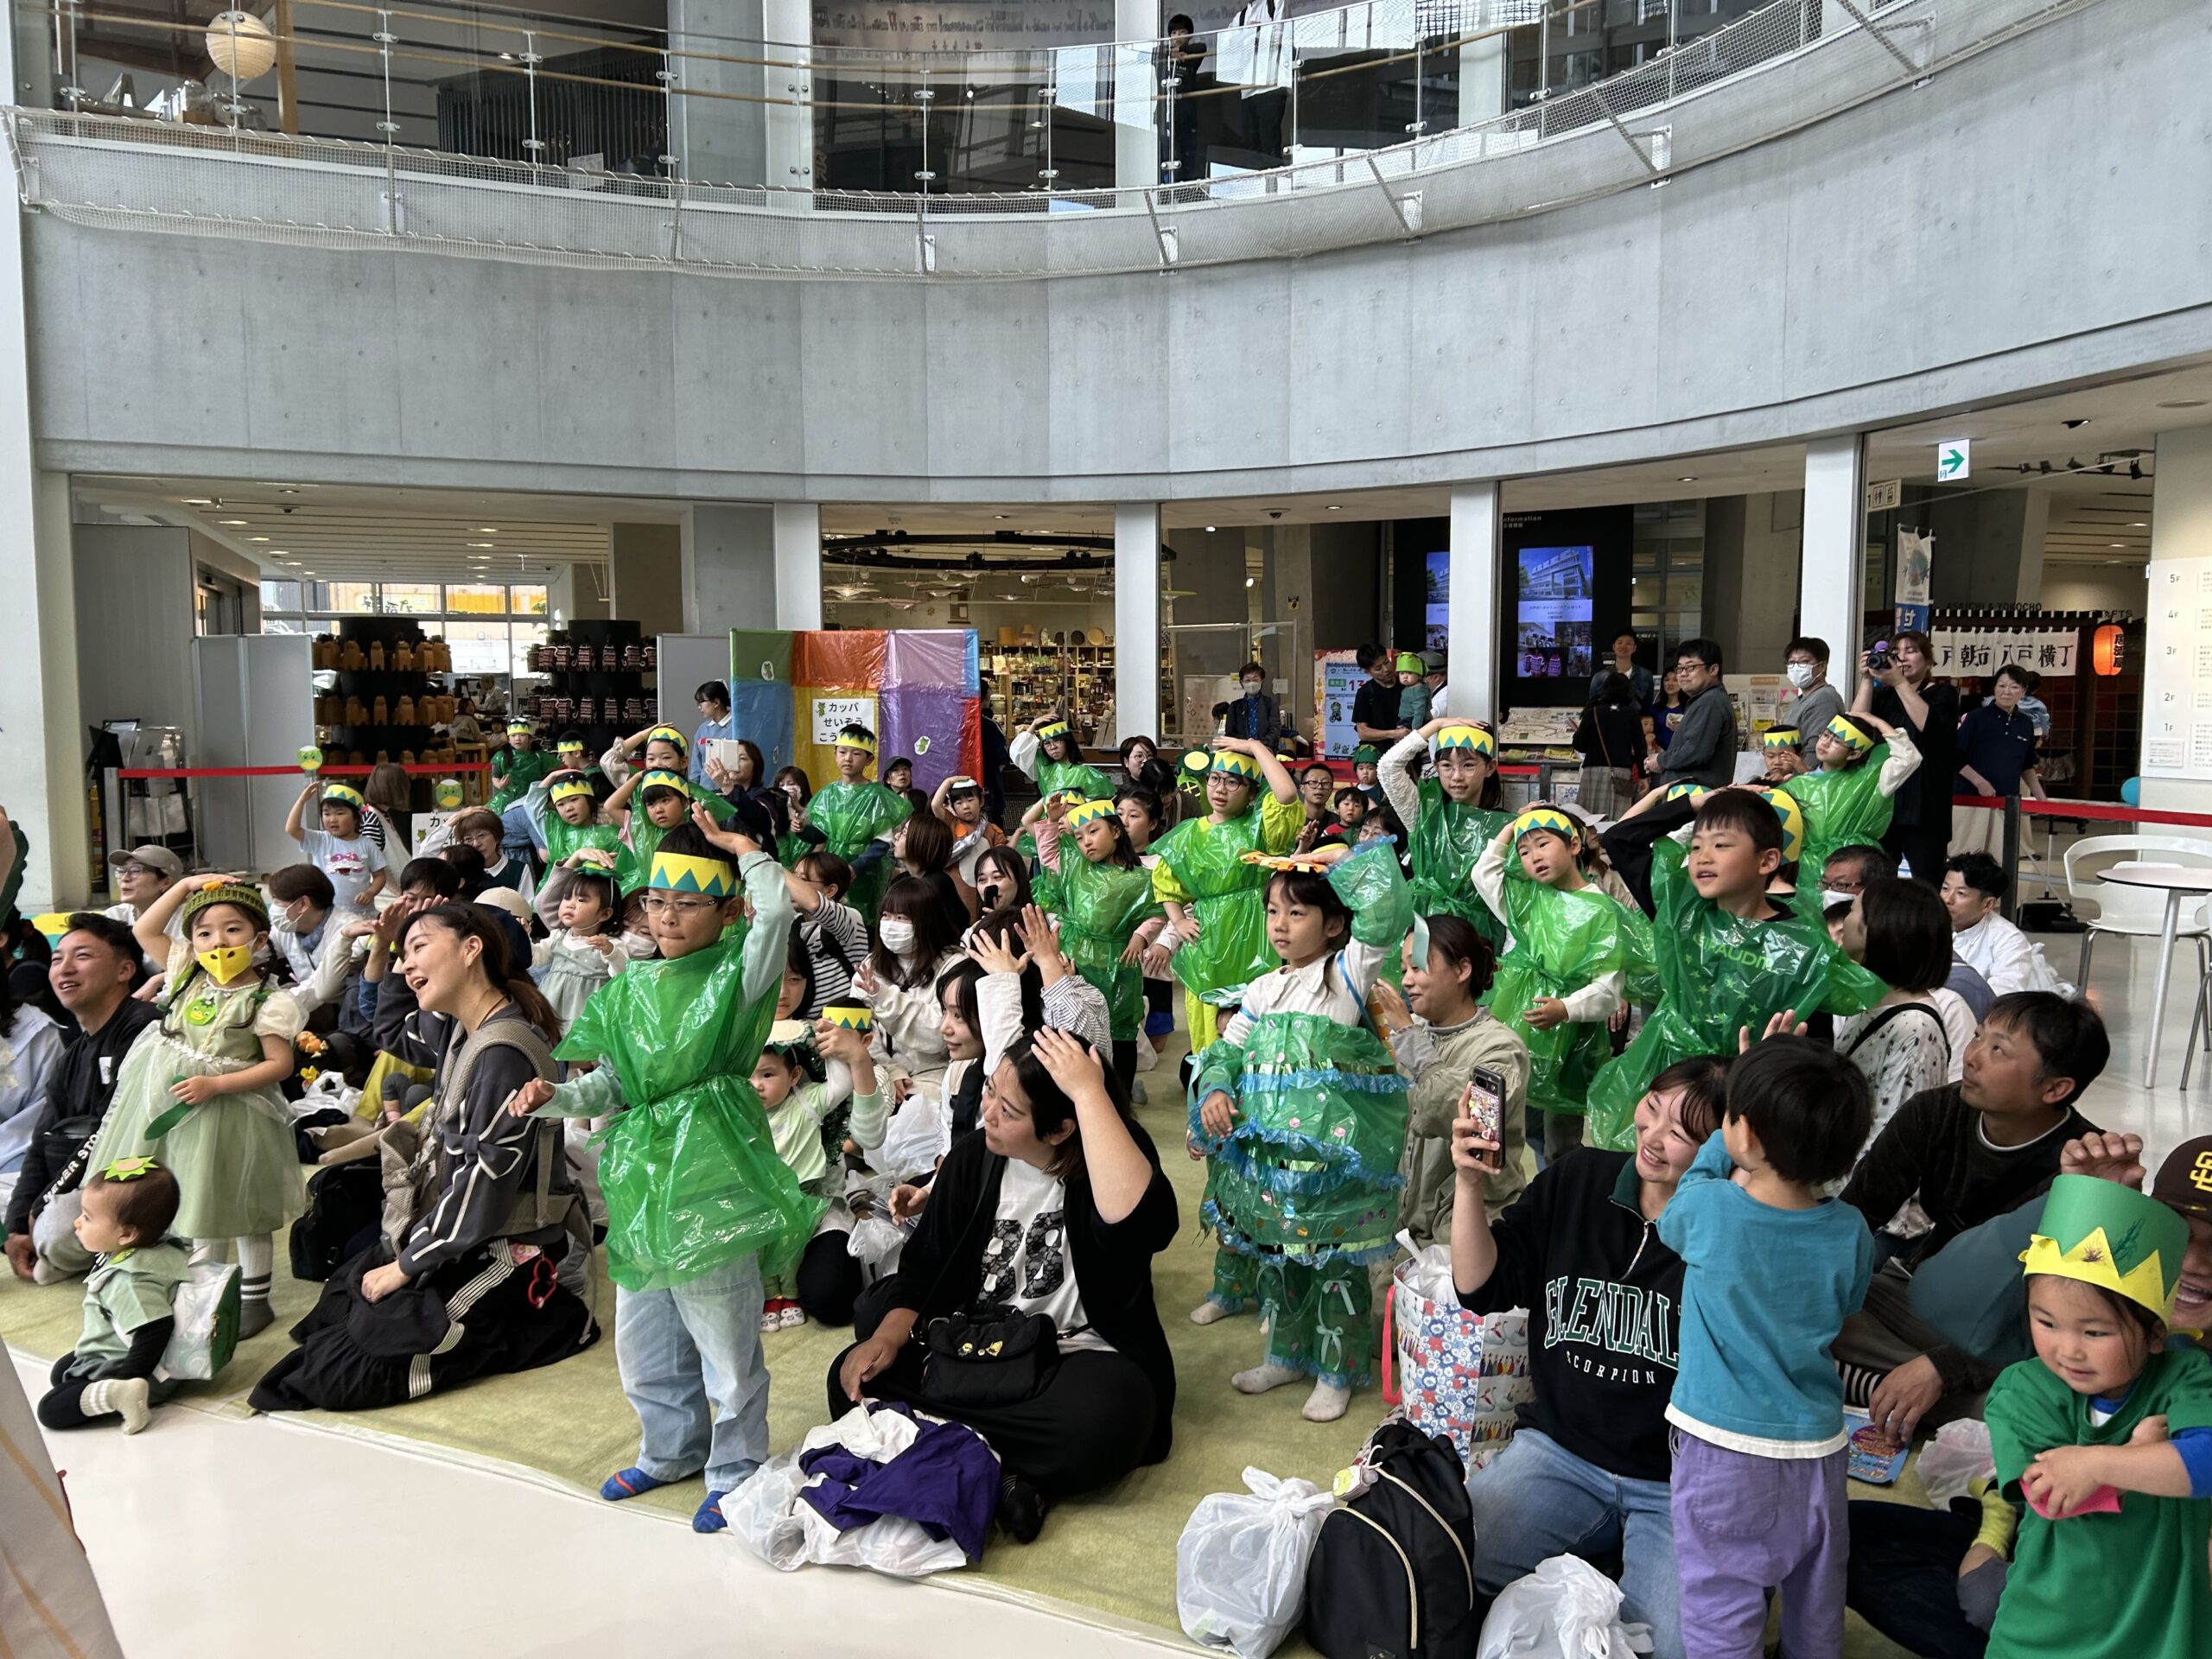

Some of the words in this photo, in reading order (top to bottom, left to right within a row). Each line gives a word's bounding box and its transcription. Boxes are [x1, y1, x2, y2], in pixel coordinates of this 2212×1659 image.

[2170, 574, 2180, 583] 5F
[2168, 610, 2179, 619] 4F
[2166, 646, 2177, 655] 3F
[2164, 692, 2176, 702] 2F
[2164, 722, 2174, 732] 1F
[42, 1160, 79, 1203] NEVER
[1544, 1276, 1681, 1370] GLENDAL
[1567, 1350, 1656, 1384] SCORPION
